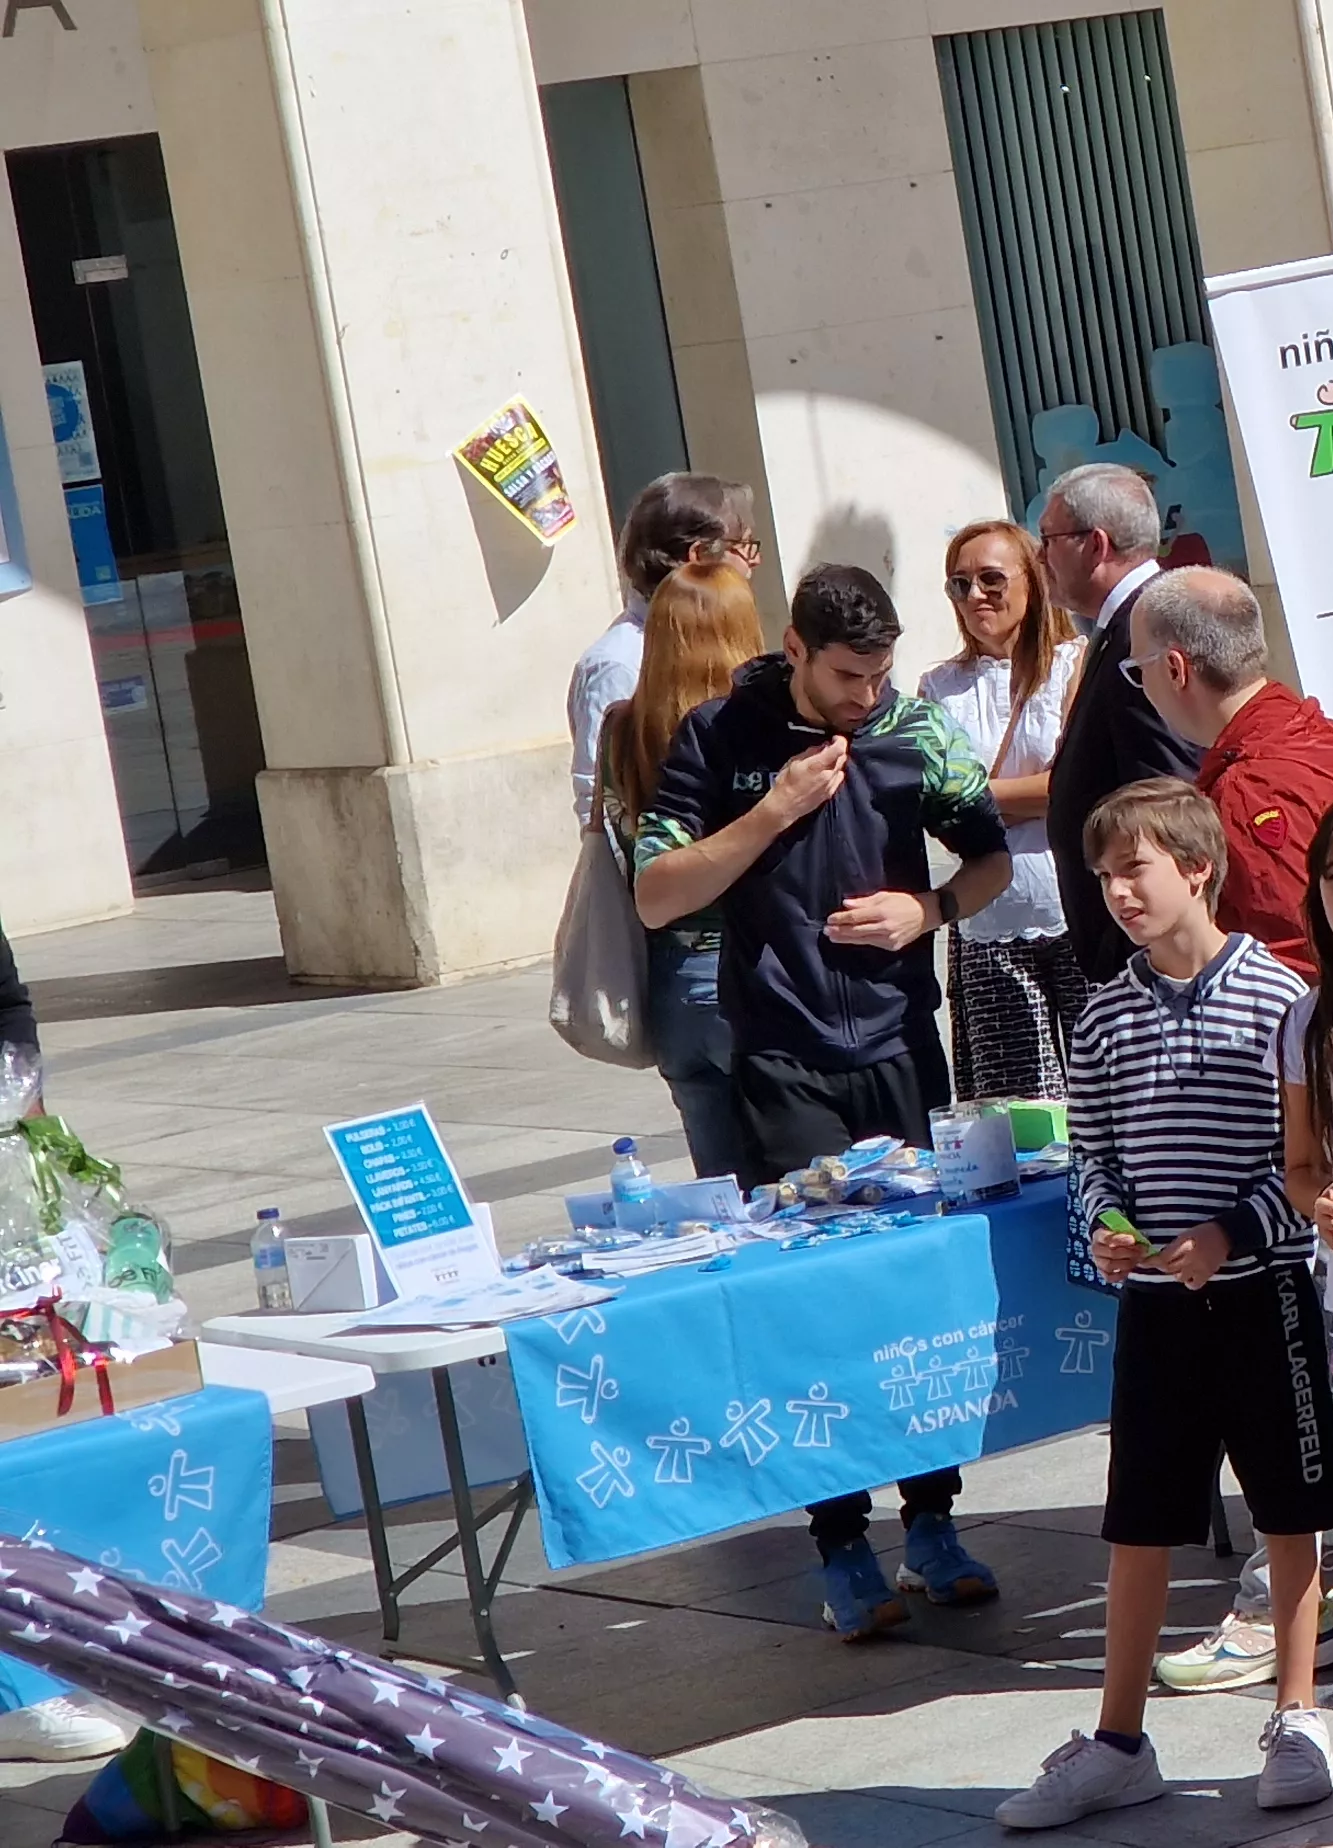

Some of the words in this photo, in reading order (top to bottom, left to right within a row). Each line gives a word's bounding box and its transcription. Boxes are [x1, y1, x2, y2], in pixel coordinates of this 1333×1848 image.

[480, 422, 539, 473] HUESCA
[1275, 1268, 1300, 1341] KARL
[932, 1328, 964, 1348] con
[905, 1388, 1019, 1436] ASPANOA
[1287, 1340, 1323, 1484] LAGERFELD
